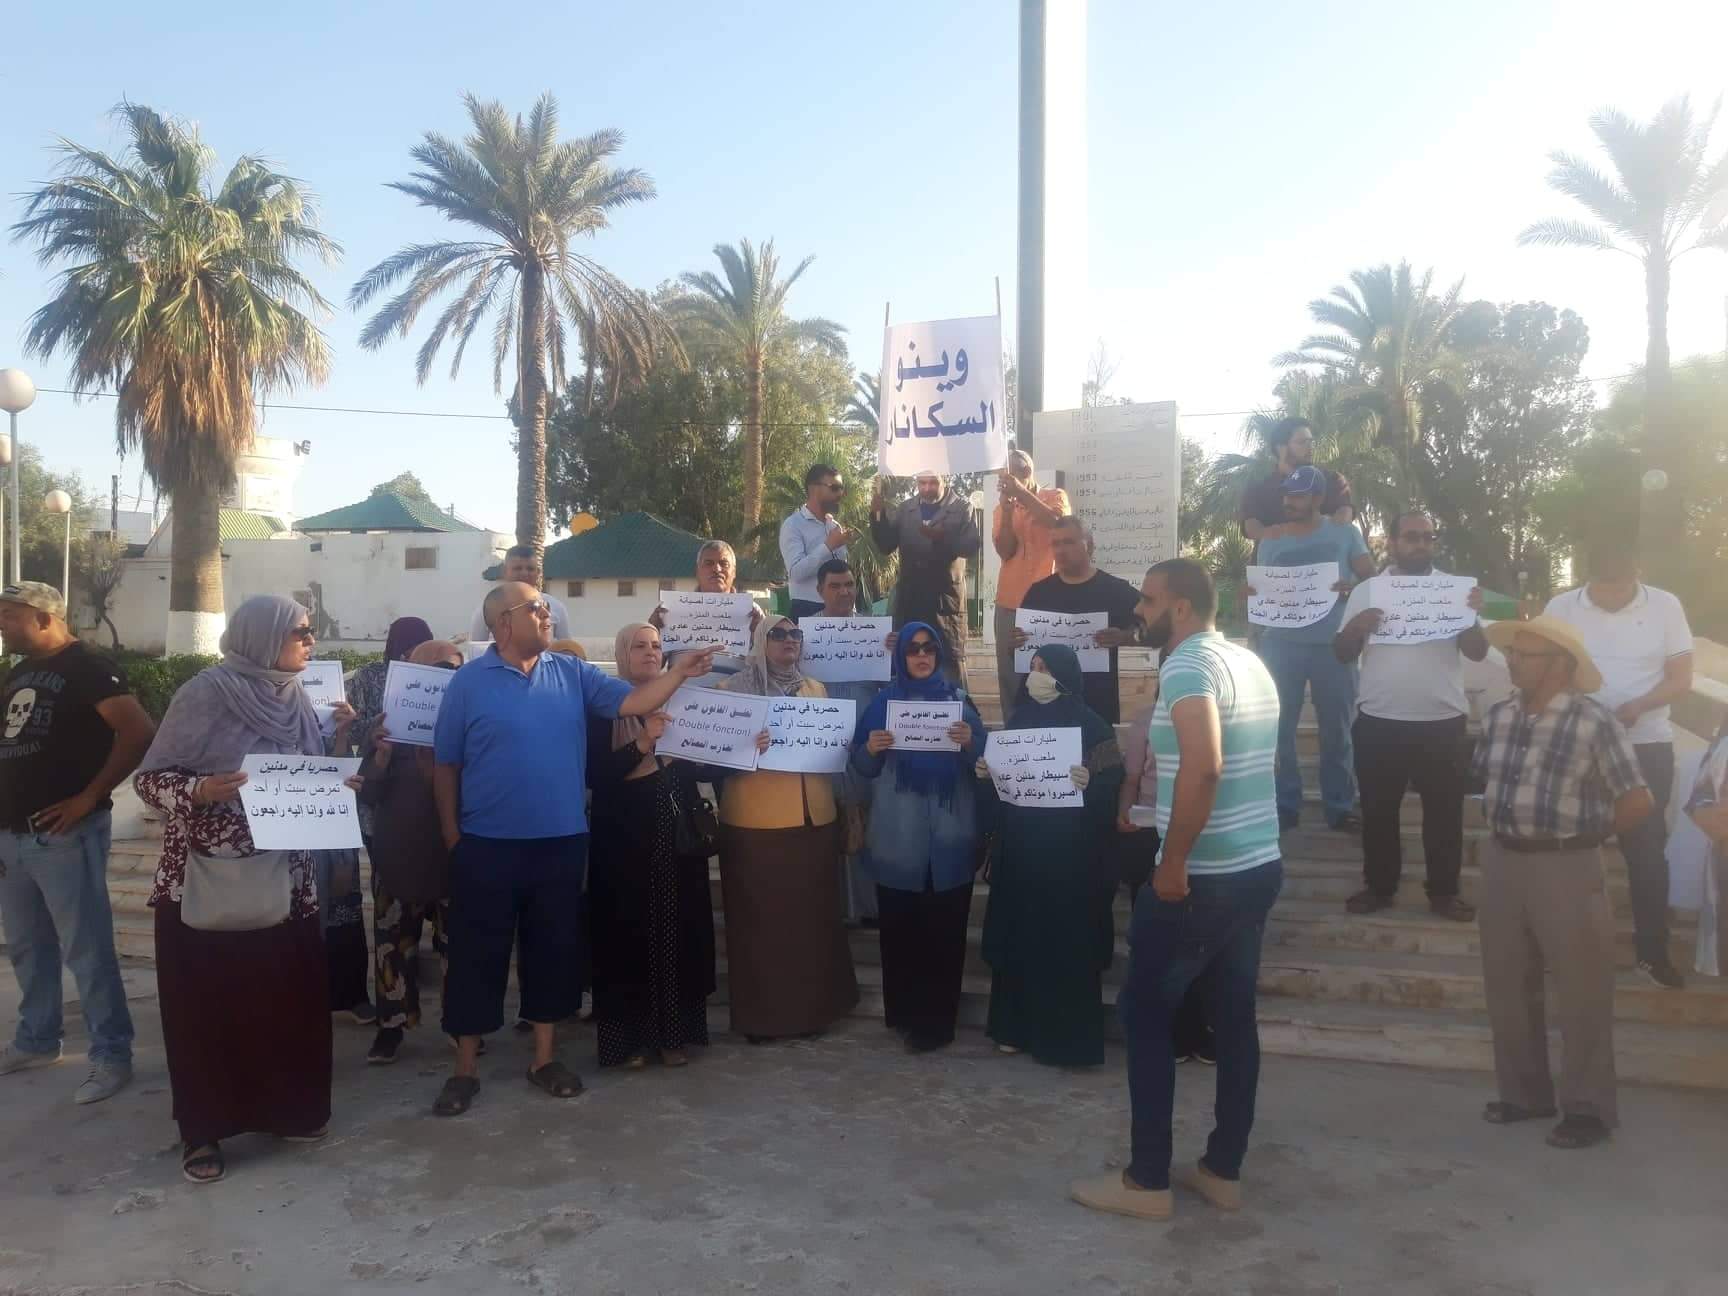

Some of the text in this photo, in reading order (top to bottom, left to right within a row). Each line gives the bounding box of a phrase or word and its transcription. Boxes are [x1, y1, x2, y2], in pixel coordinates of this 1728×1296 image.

[896, 340, 969, 393] وينو
[884, 399, 995, 445] السكانار
[679, 595, 734, 607] مليارات لصيانة
[1257, 597, 1276, 606] عادي
[1279, 598, 1300, 608] مدنين
[1029, 615, 1091, 627] حصريا في مدنين
[1270, 610, 1281, 621] في
[1406, 612, 1429, 623] مدنين
[670, 623, 741, 632] سبيطار مدنين عادي
[814, 620, 876, 632] حصريا في مدنين
[662, 634, 681, 643] الجنة
[682, 634, 693, 643] في
[1395, 626, 1407, 639] في
[695, 635, 719, 644] موتاكم
[808, 634, 823, 644] أحد
[804, 651, 833, 661] راجعون
[701, 703, 729, 716] القانون
[772, 702, 840, 718] حصريا في مدنين
[911, 711, 931, 720] القانون
[679, 718, 711, 732] Double
[769, 717, 784, 728] أحد
[681, 736, 709, 749] المصالح
[997, 732, 1057, 746] مليارات لصيانة
[1032, 752, 1056, 761] ملعب
[259, 759, 338, 776] حصريا في مدنين
[1015, 771, 1035, 783] مدنين
[1039, 769, 1069, 782] سبيطار
[254, 778, 341, 796] تمرض سبت أو أحد
[1024, 788, 1046, 800] موتاكم
[250, 804, 285, 818] راجعون
[326, 804, 336, 816] لله
